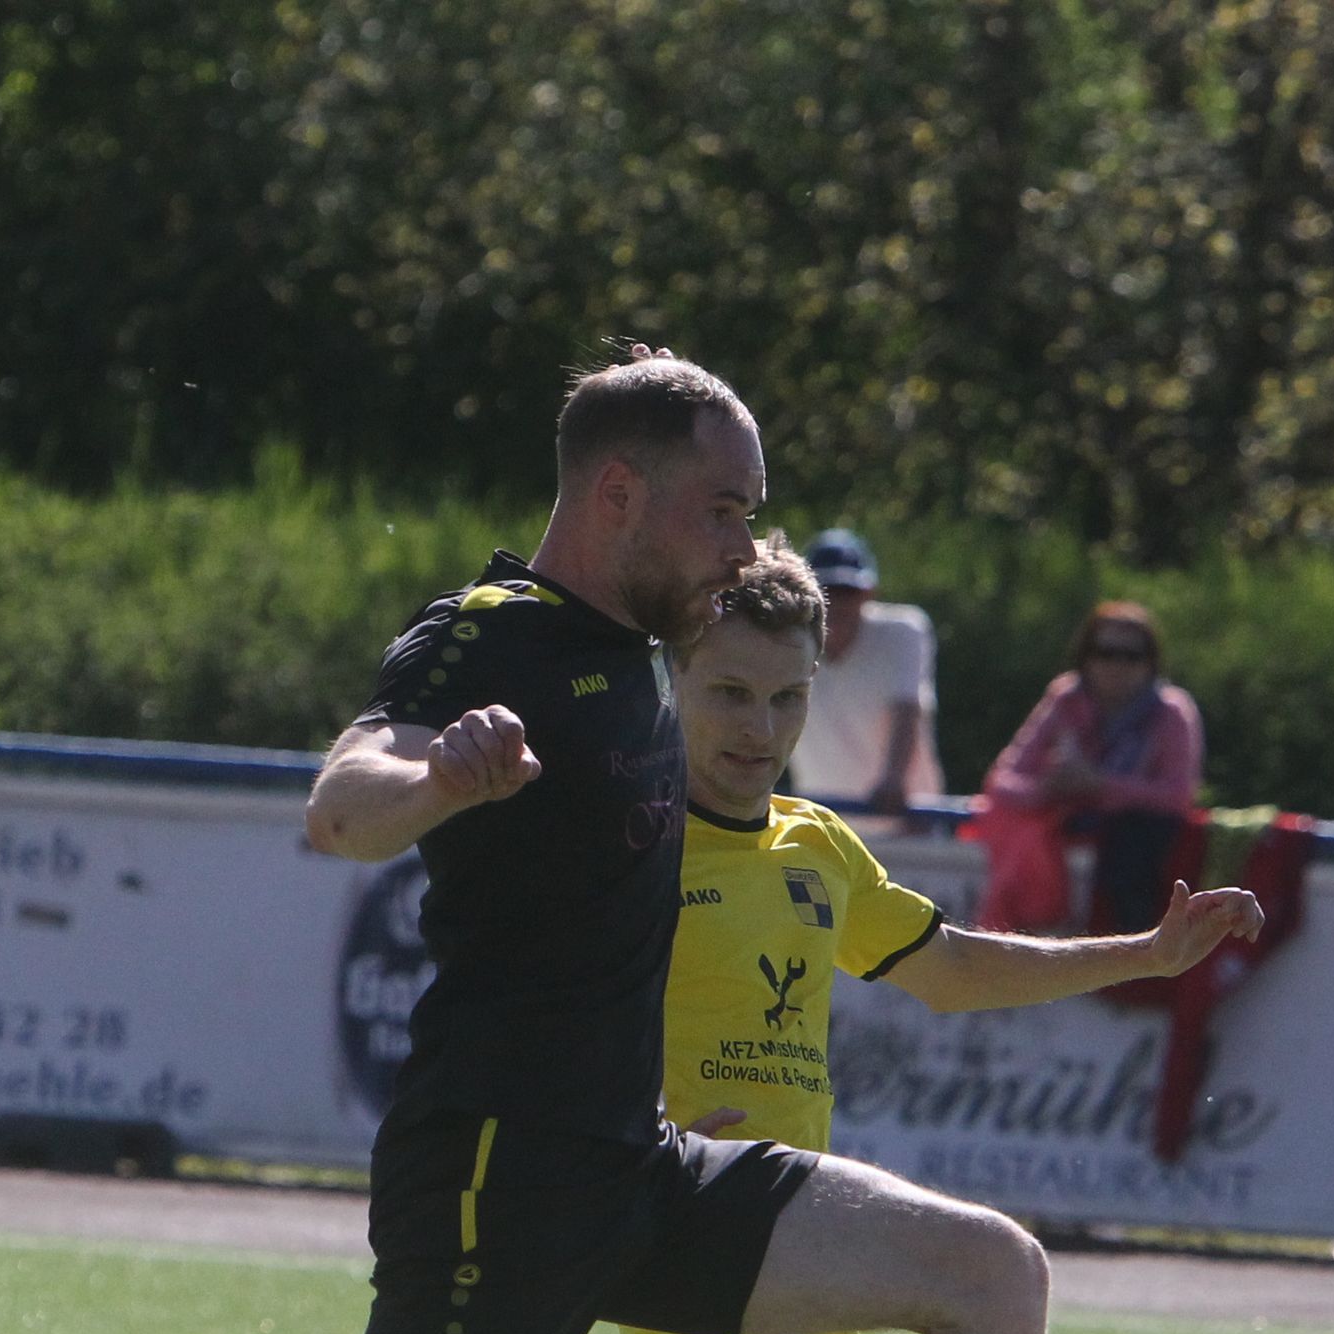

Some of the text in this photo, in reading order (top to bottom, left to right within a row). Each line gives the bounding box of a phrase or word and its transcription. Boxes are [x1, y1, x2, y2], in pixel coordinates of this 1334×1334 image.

[571, 673, 609, 697] JAKO
[720, 1039, 759, 1060] KFZ
[781, 1066, 793, 1086] &
[833, 1028, 1280, 1152] ermühe
